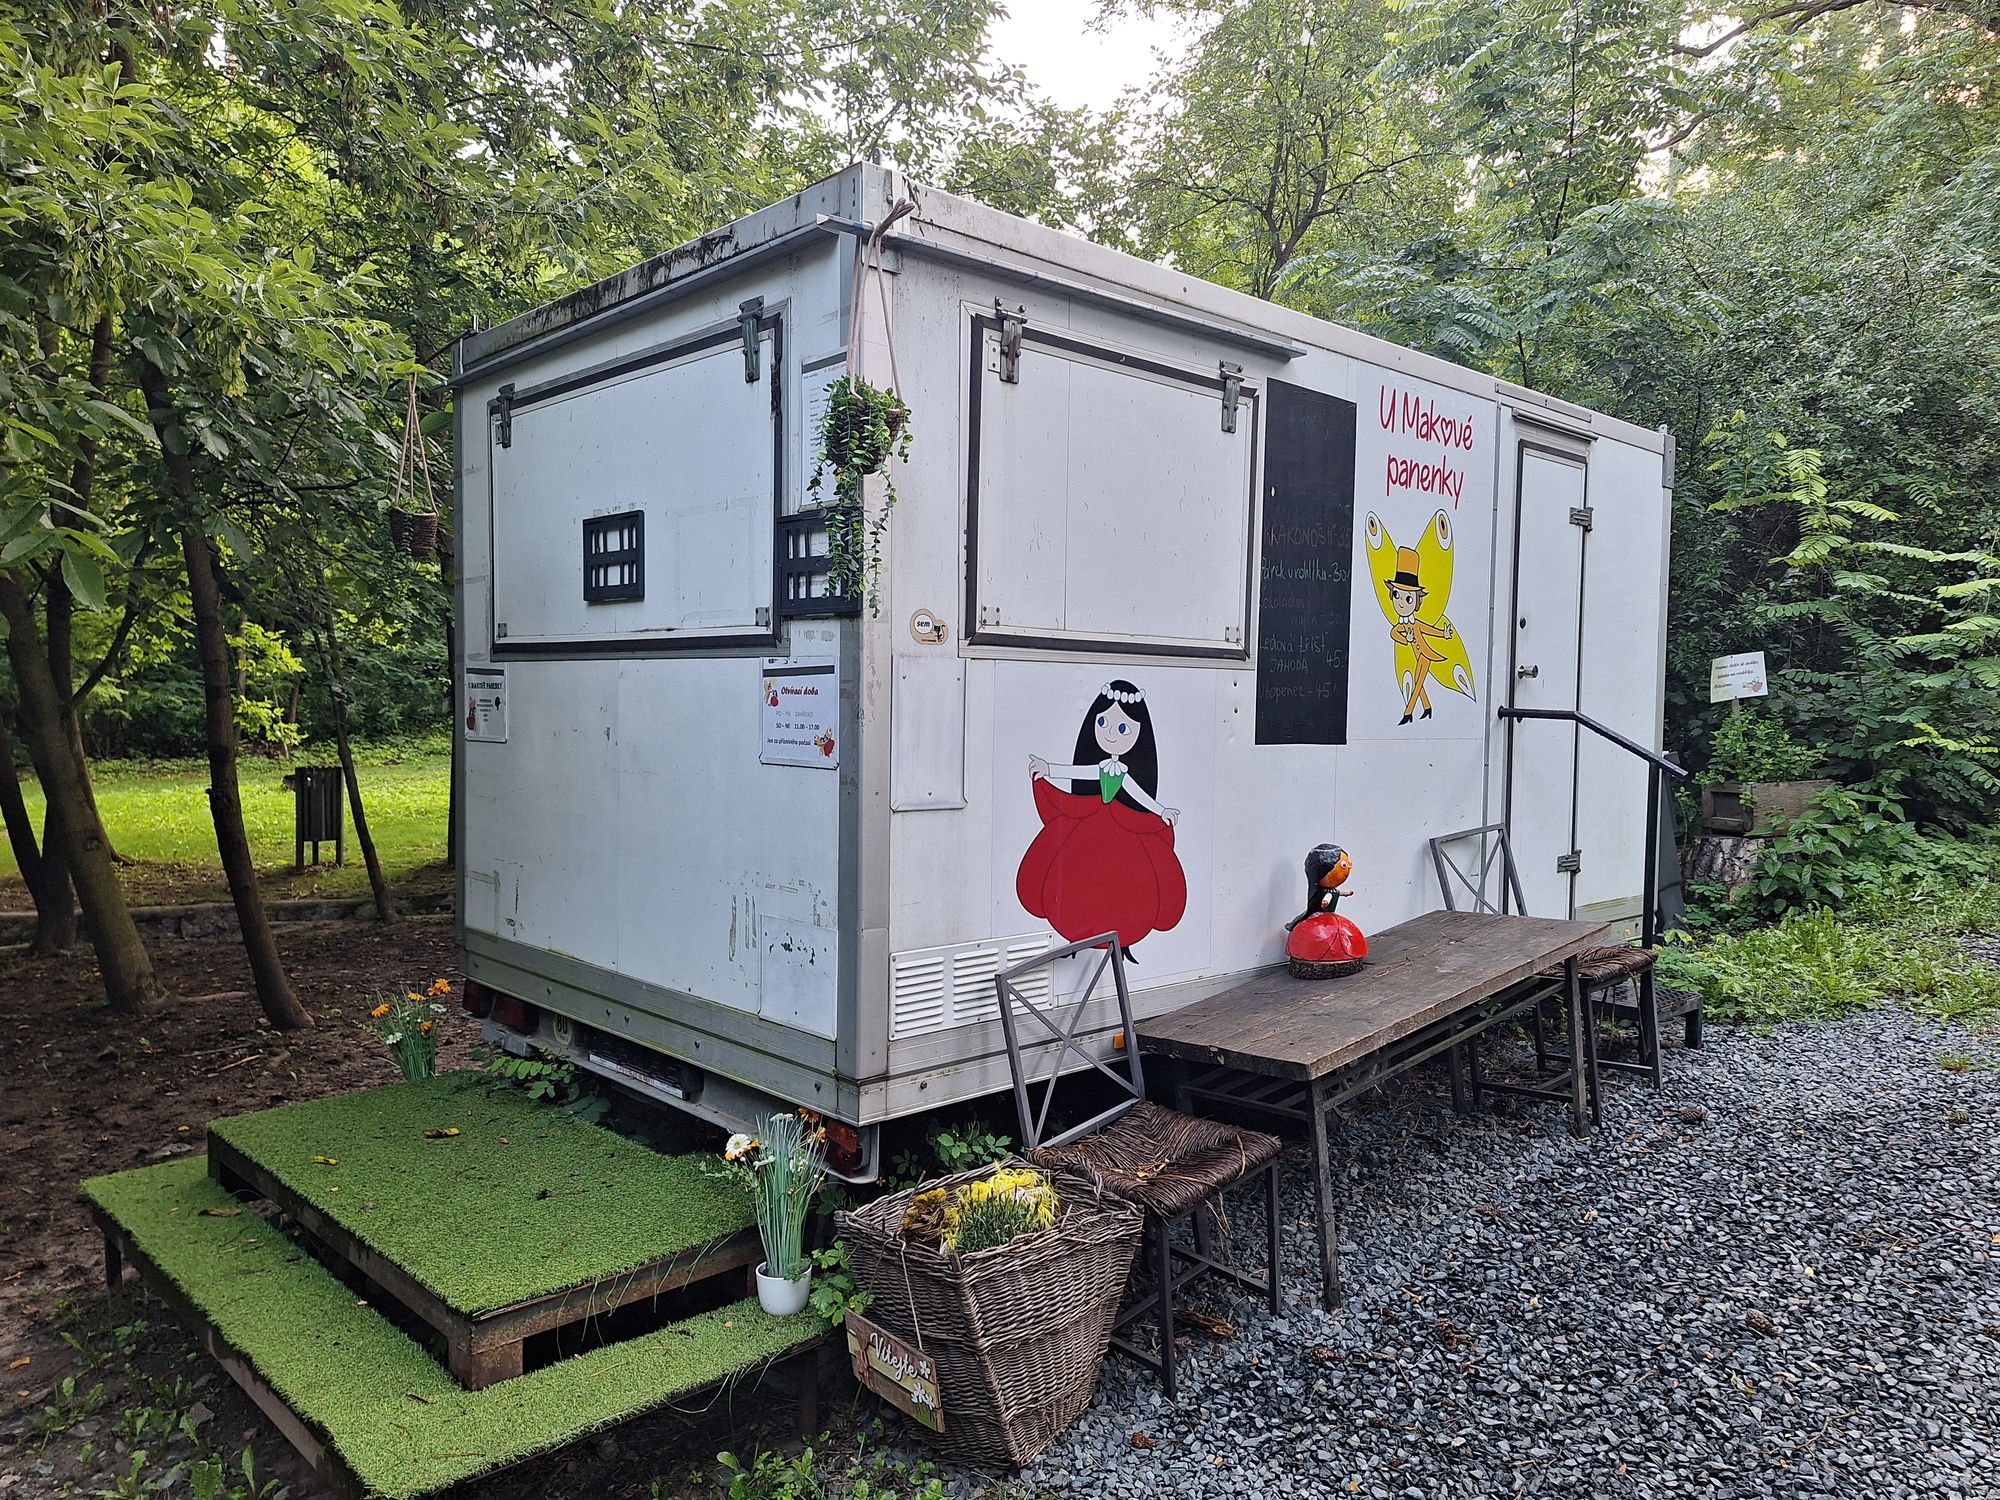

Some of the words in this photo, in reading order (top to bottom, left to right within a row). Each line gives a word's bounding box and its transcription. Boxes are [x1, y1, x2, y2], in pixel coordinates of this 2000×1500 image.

[1380, 384, 1396, 434] U
[1386, 453, 1465, 510] panenky
[1269, 658, 1308, 674] JAHODA
[781, 686, 802, 696] Otvírací
[803, 687, 818, 696] doba
